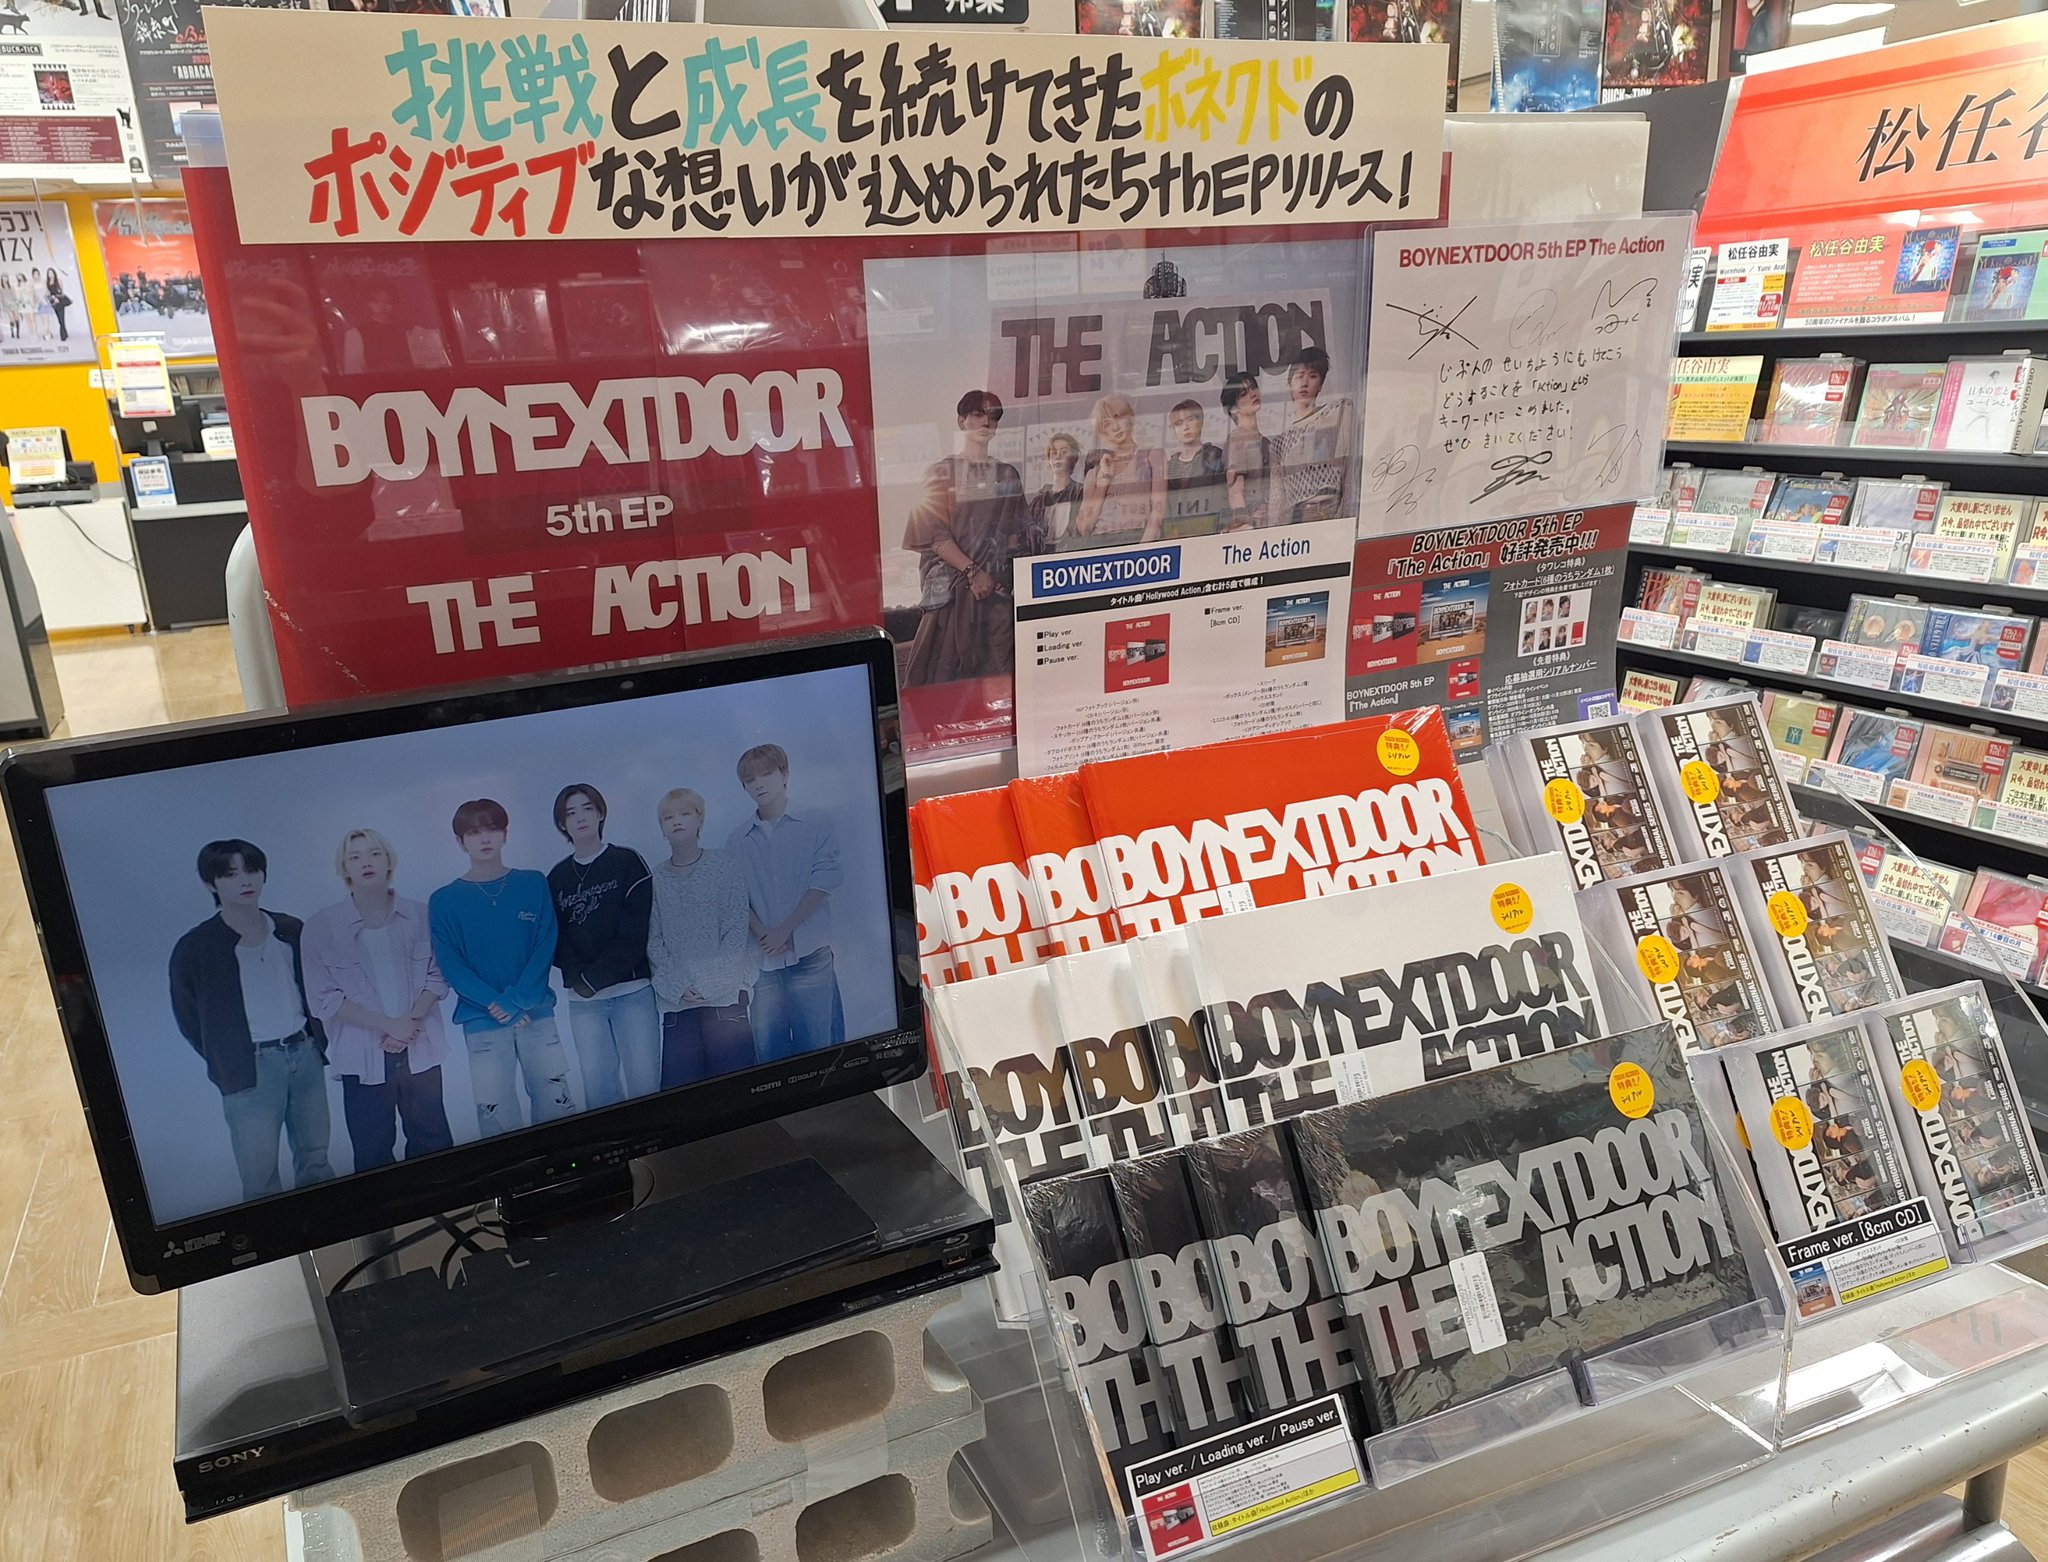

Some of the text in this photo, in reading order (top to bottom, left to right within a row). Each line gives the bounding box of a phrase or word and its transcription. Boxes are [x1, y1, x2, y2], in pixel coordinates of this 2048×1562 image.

[384, 28, 1354, 150] 挑戦と成長を続けてきたボネクドの
[1399, 235, 1666, 269] BOYNEXTDOOR 5th EP The Action
[1728, 243, 1779, 260] 松任谷由実
[1809, 235, 1886, 258] 松任谷由実
[1001, 299, 1328, 399] THE ACTION
[1676, 357, 1731, 375] 任谷由実
[300, 367, 855, 487] BOYNEXTDOOR
[2011, 367, 2036, 452] ORIGINAL ALBUM
[545, 494, 675, 538] 5th EP
[1411, 512, 1584, 555] BOYNEXTDOOR 5th EP
[1042, 536, 1311, 590] BOYNEXTDOOR The Action
[1387, 557, 1430, 579] 『The
[1431, 550, 1491, 574] Action』
[406, 547, 812, 655] THE ACTION
[1210, 615, 1241, 629] [8cm CD]
[1211, 603, 1245, 614] Frame ver.
[1043, 628, 1074, 639] Play ver.
[1044, 641, 1085, 653] Loading ver.
[1044, 656, 1064, 665] Pause
[1346, 676, 1436, 701] BOYNEXTDOOR 5th EP
[1643, 802, 1668, 859] ORIGINAL SERIES
[1767, 778, 1795, 834] ORIGINAL SERIES
[1098, 778, 1470, 910] BOYNEXTDOOR
[1862, 923, 1893, 988] ORIGINAL SERIES
[1206, 929, 1591, 1081] BOYNEXTDOOR
[1736, 952, 1766, 1020] ORIGINAL SERIES
[750, 1080, 782, 1094] HDMI
[1996, 1083, 2028, 1158] ORIGINAL SERIES
[1872, 1120, 1903, 1190] ORIGINAL SERIES
[1315, 1108, 1710, 1293] BOYNEXTDOOR
[1540, 1178, 1735, 1318] ACTION
[1788, 1204, 1923, 1263] Frame ver. [8cm CD]
[1346, 1264, 1470, 1378] THE
[198, 1446, 267, 1475] SONY
[1135, 1411, 1339, 1489] Play ver. / Loading ver. / Pause ver.
